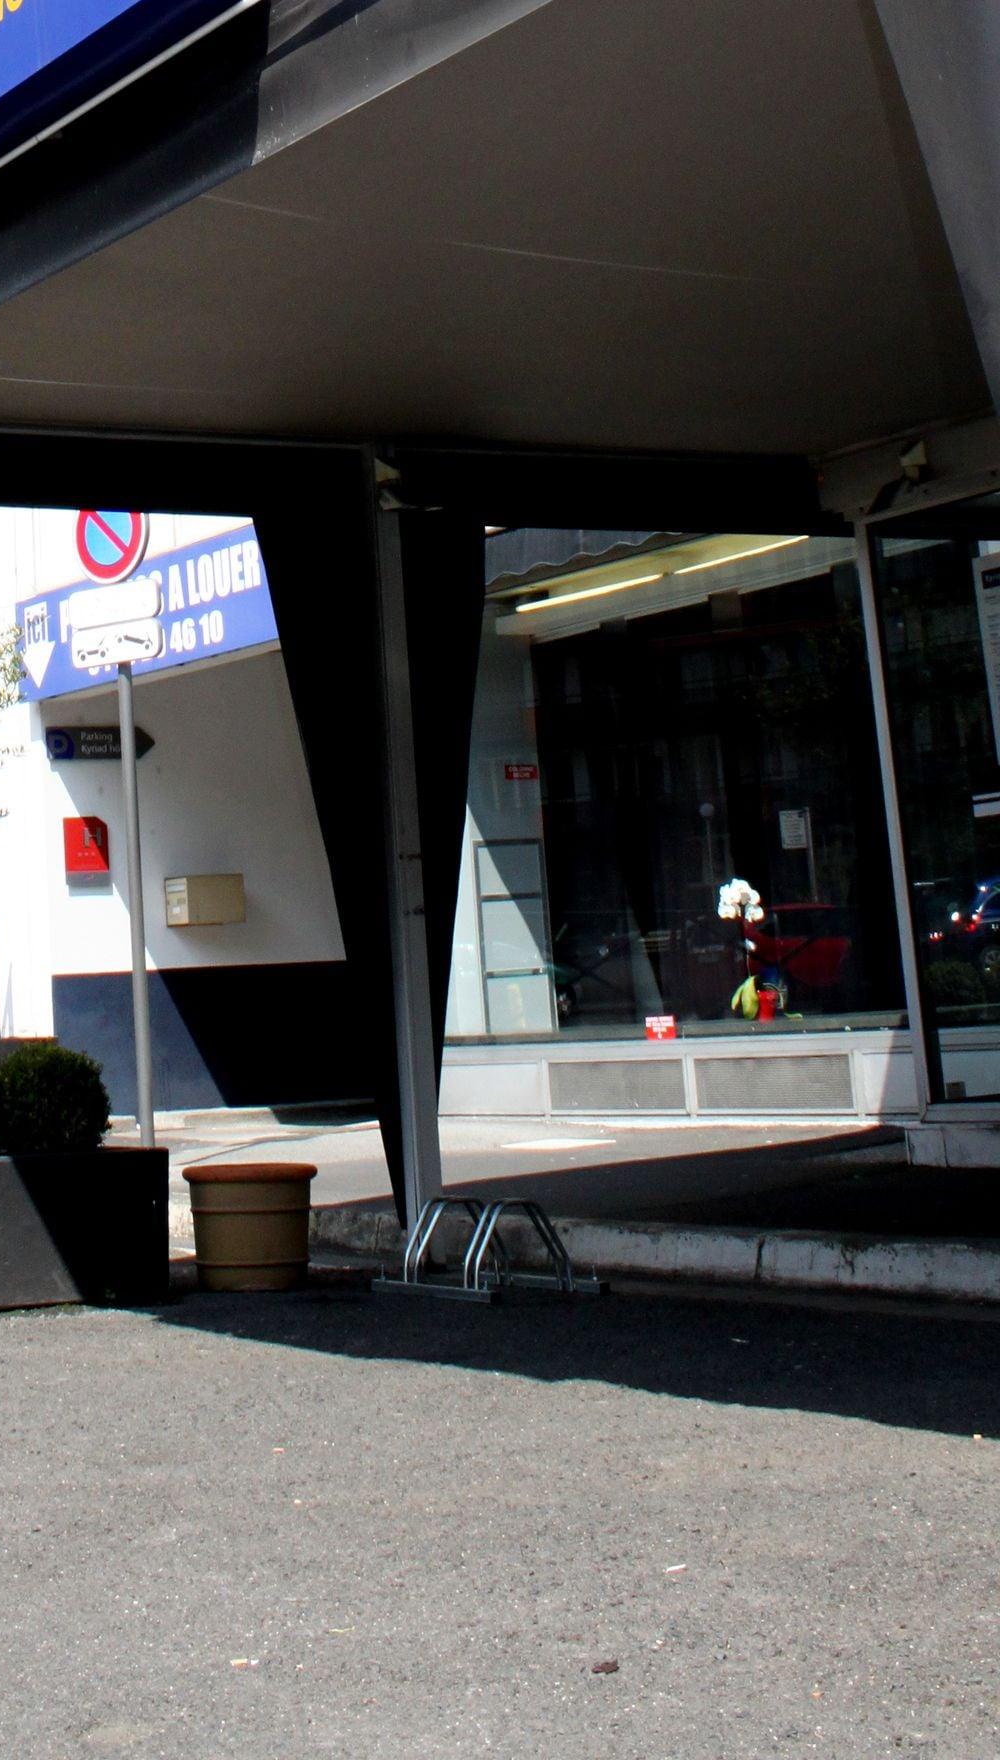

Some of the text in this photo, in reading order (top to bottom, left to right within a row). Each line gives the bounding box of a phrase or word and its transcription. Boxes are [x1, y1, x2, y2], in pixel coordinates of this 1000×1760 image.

[168, 564, 185, 612] A
[186, 539, 261, 606] LOUER
[26, 606, 46, 644] ici
[169, 617, 197, 653] 46
[198, 609, 224, 646] 10
[81, 731, 113, 743] Parking
[81, 744, 108, 754] Kyriad
